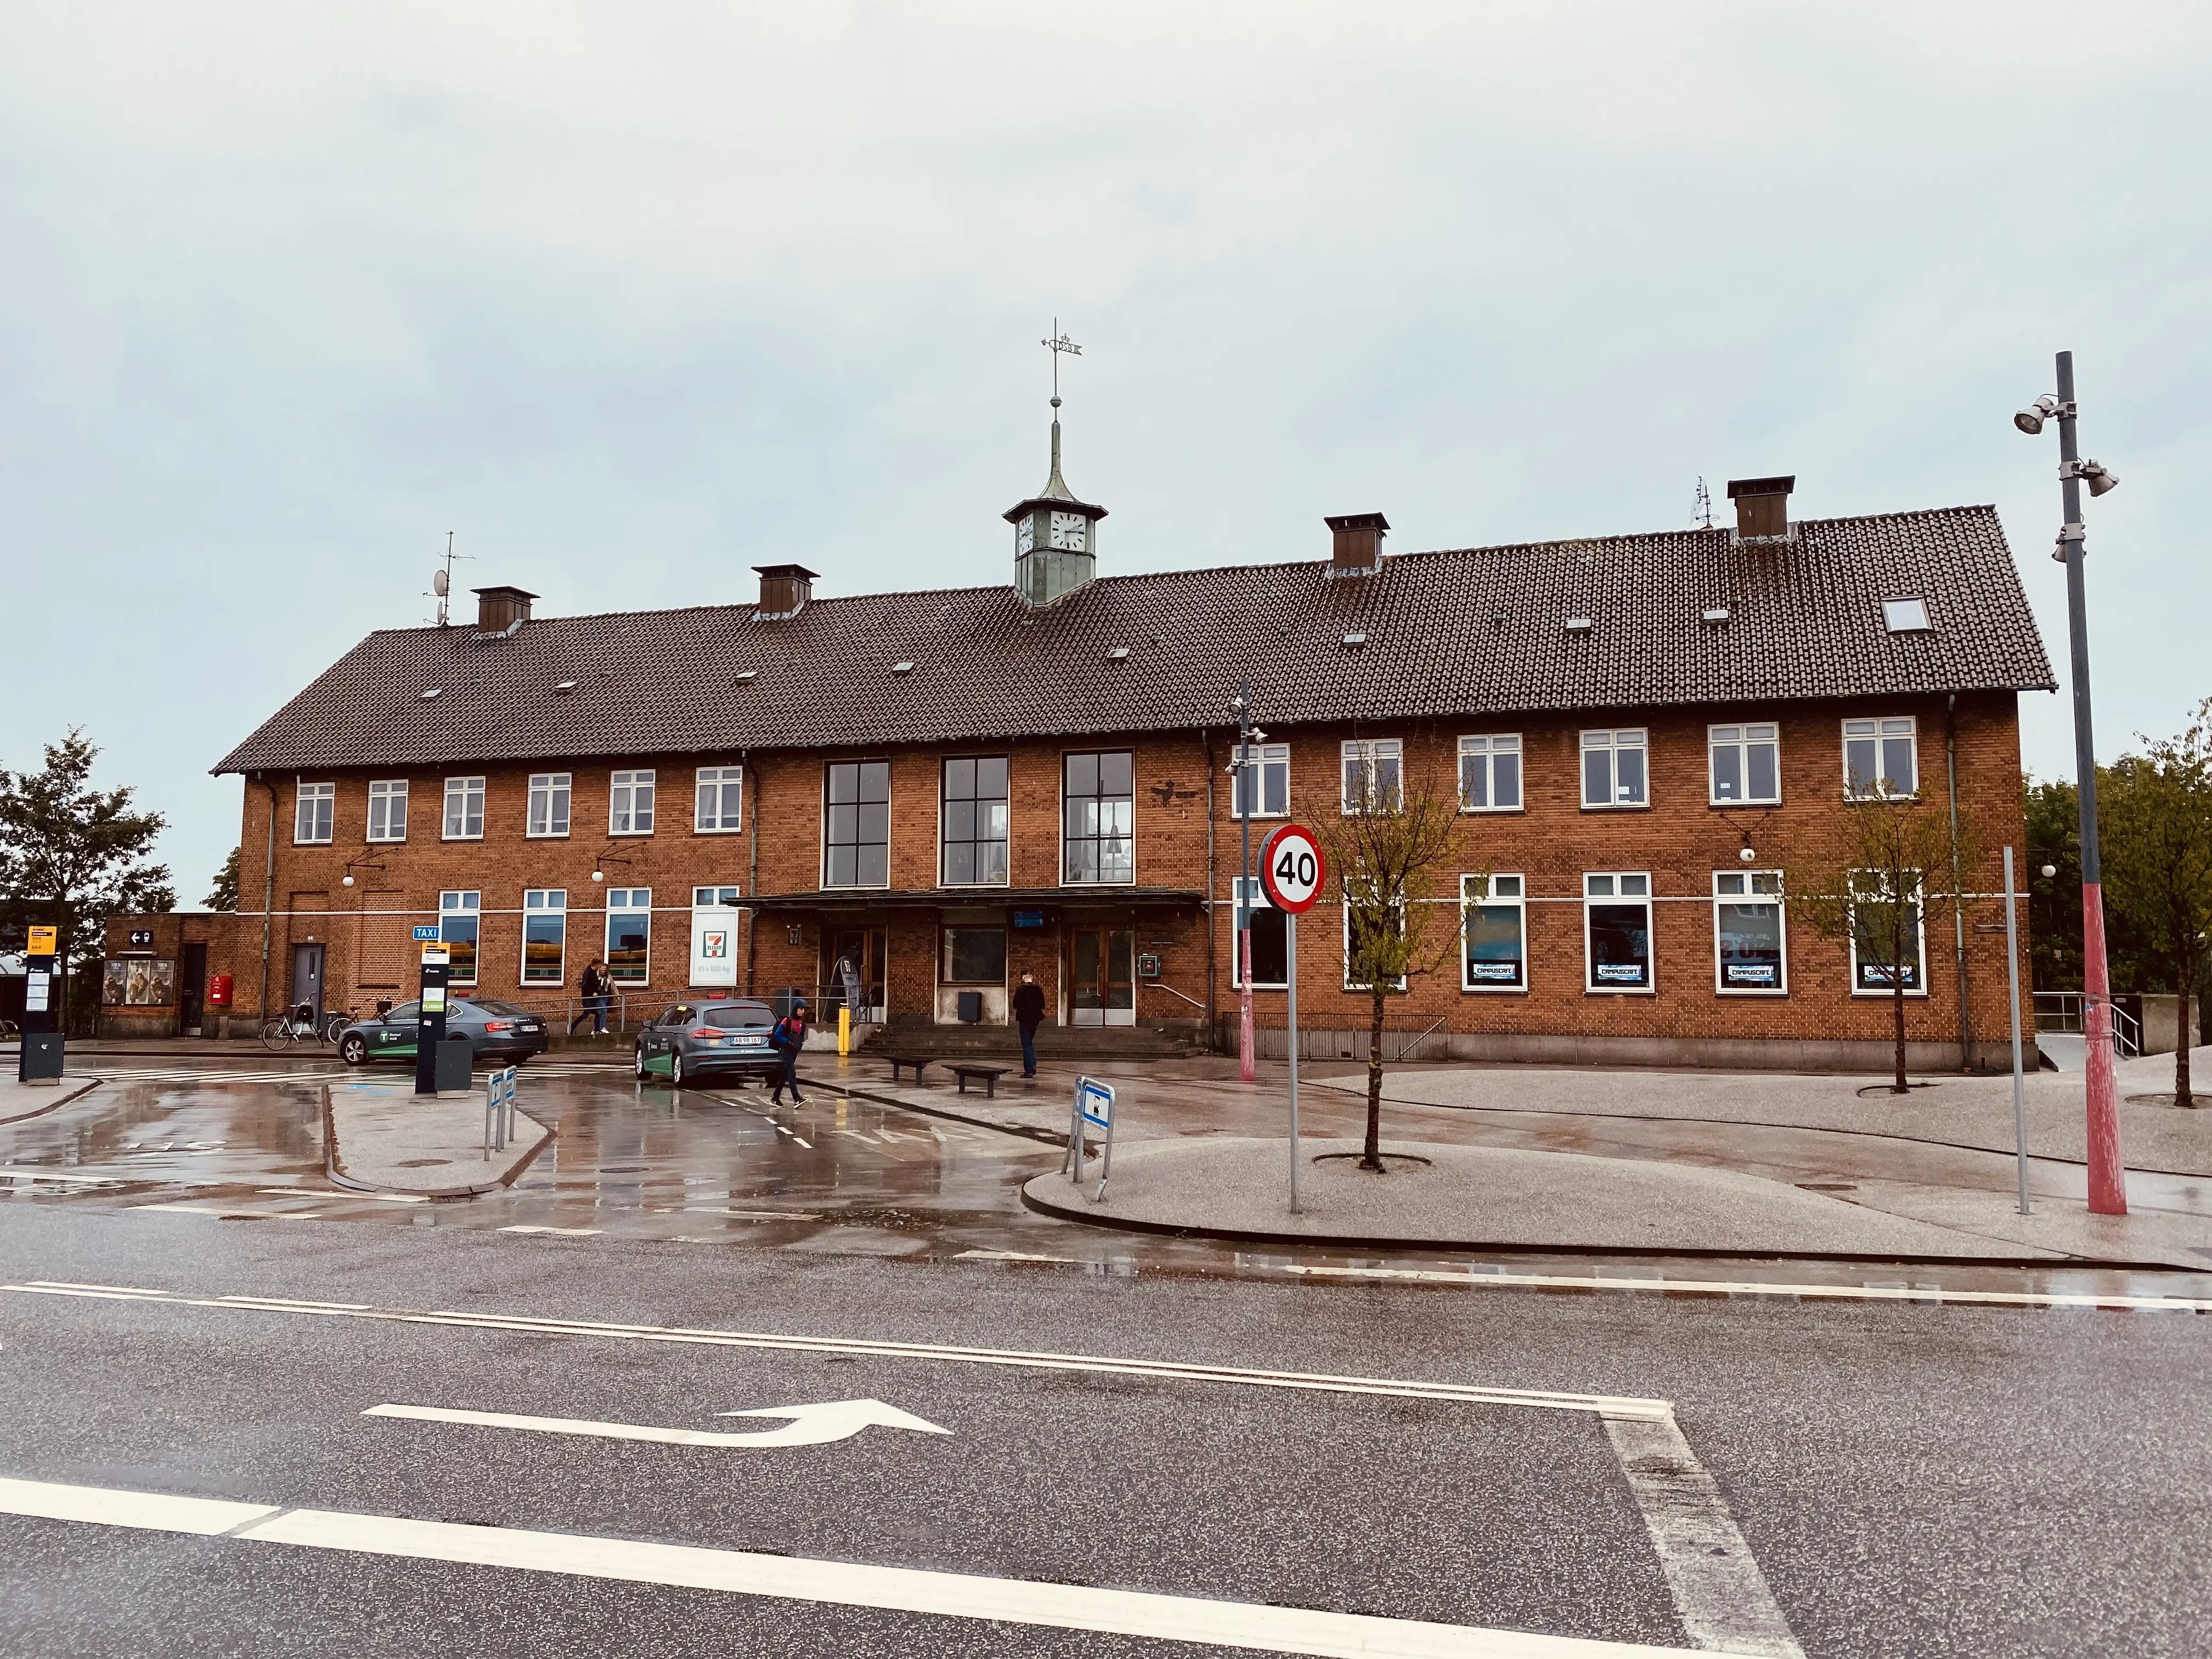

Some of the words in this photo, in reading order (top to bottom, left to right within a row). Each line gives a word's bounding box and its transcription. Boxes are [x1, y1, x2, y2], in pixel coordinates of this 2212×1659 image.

[1059, 342, 1072, 352] DSB
[1276, 851, 1316, 887] 40
[416, 928, 437, 938] TAXI
[830, 1125, 997, 1144] TAXI
